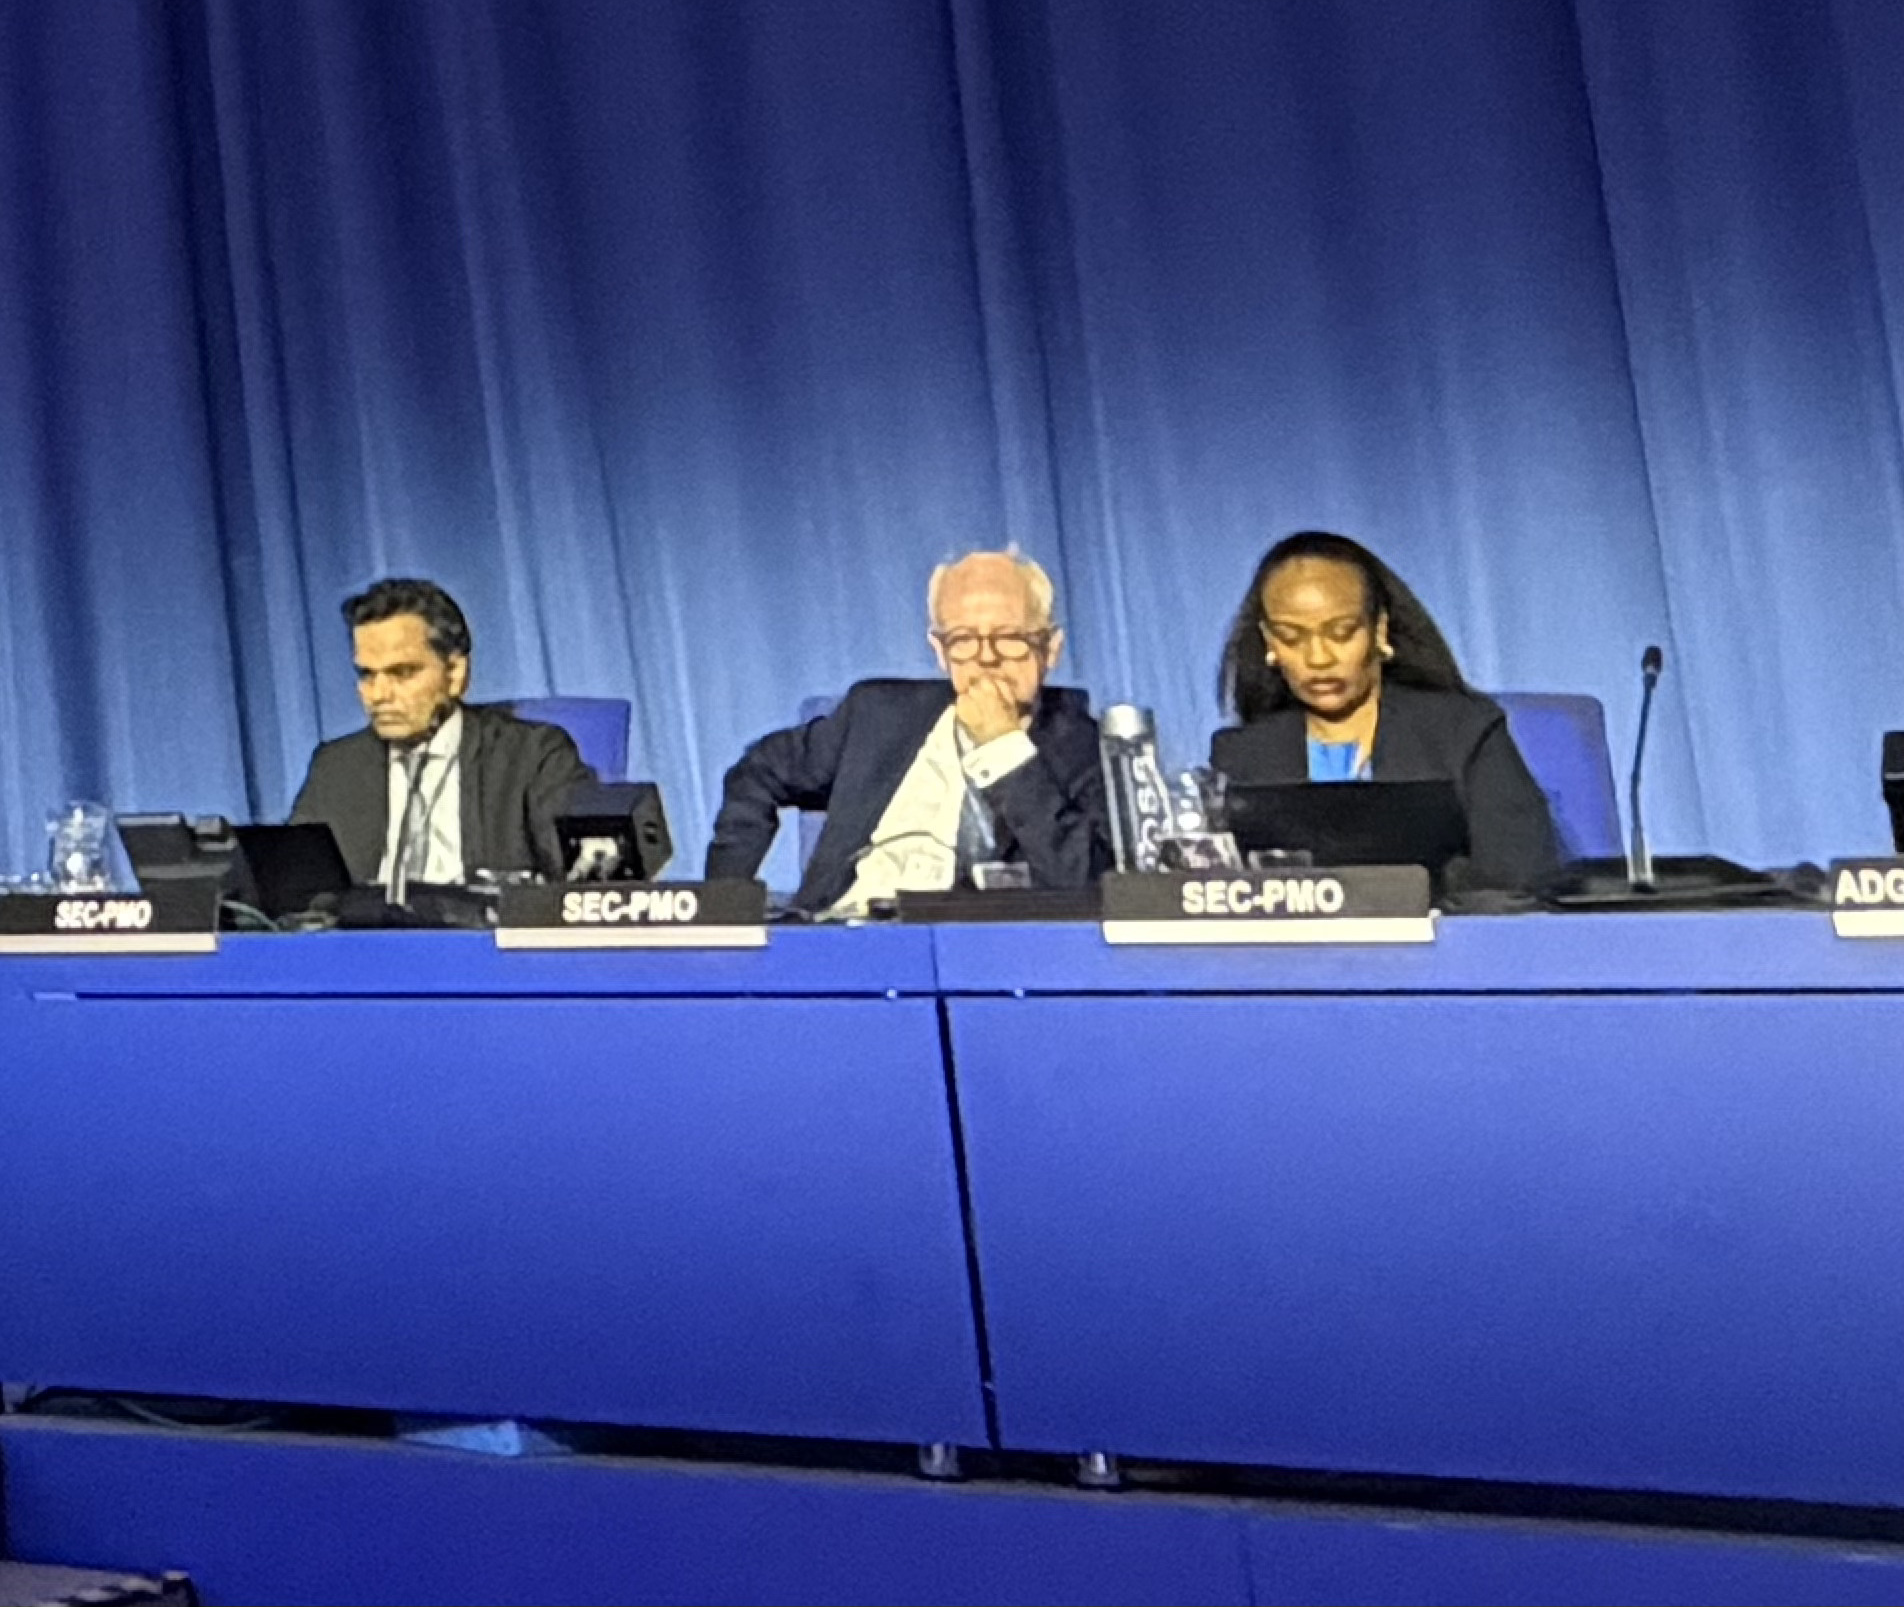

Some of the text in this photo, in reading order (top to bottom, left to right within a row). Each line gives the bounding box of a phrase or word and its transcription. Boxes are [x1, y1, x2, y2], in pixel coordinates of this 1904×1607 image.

[561, 889, 698, 923] SEC-PMO
[1182, 878, 1344, 913] SEC-PMO
[54, 899, 153, 929] SEC-PMO
